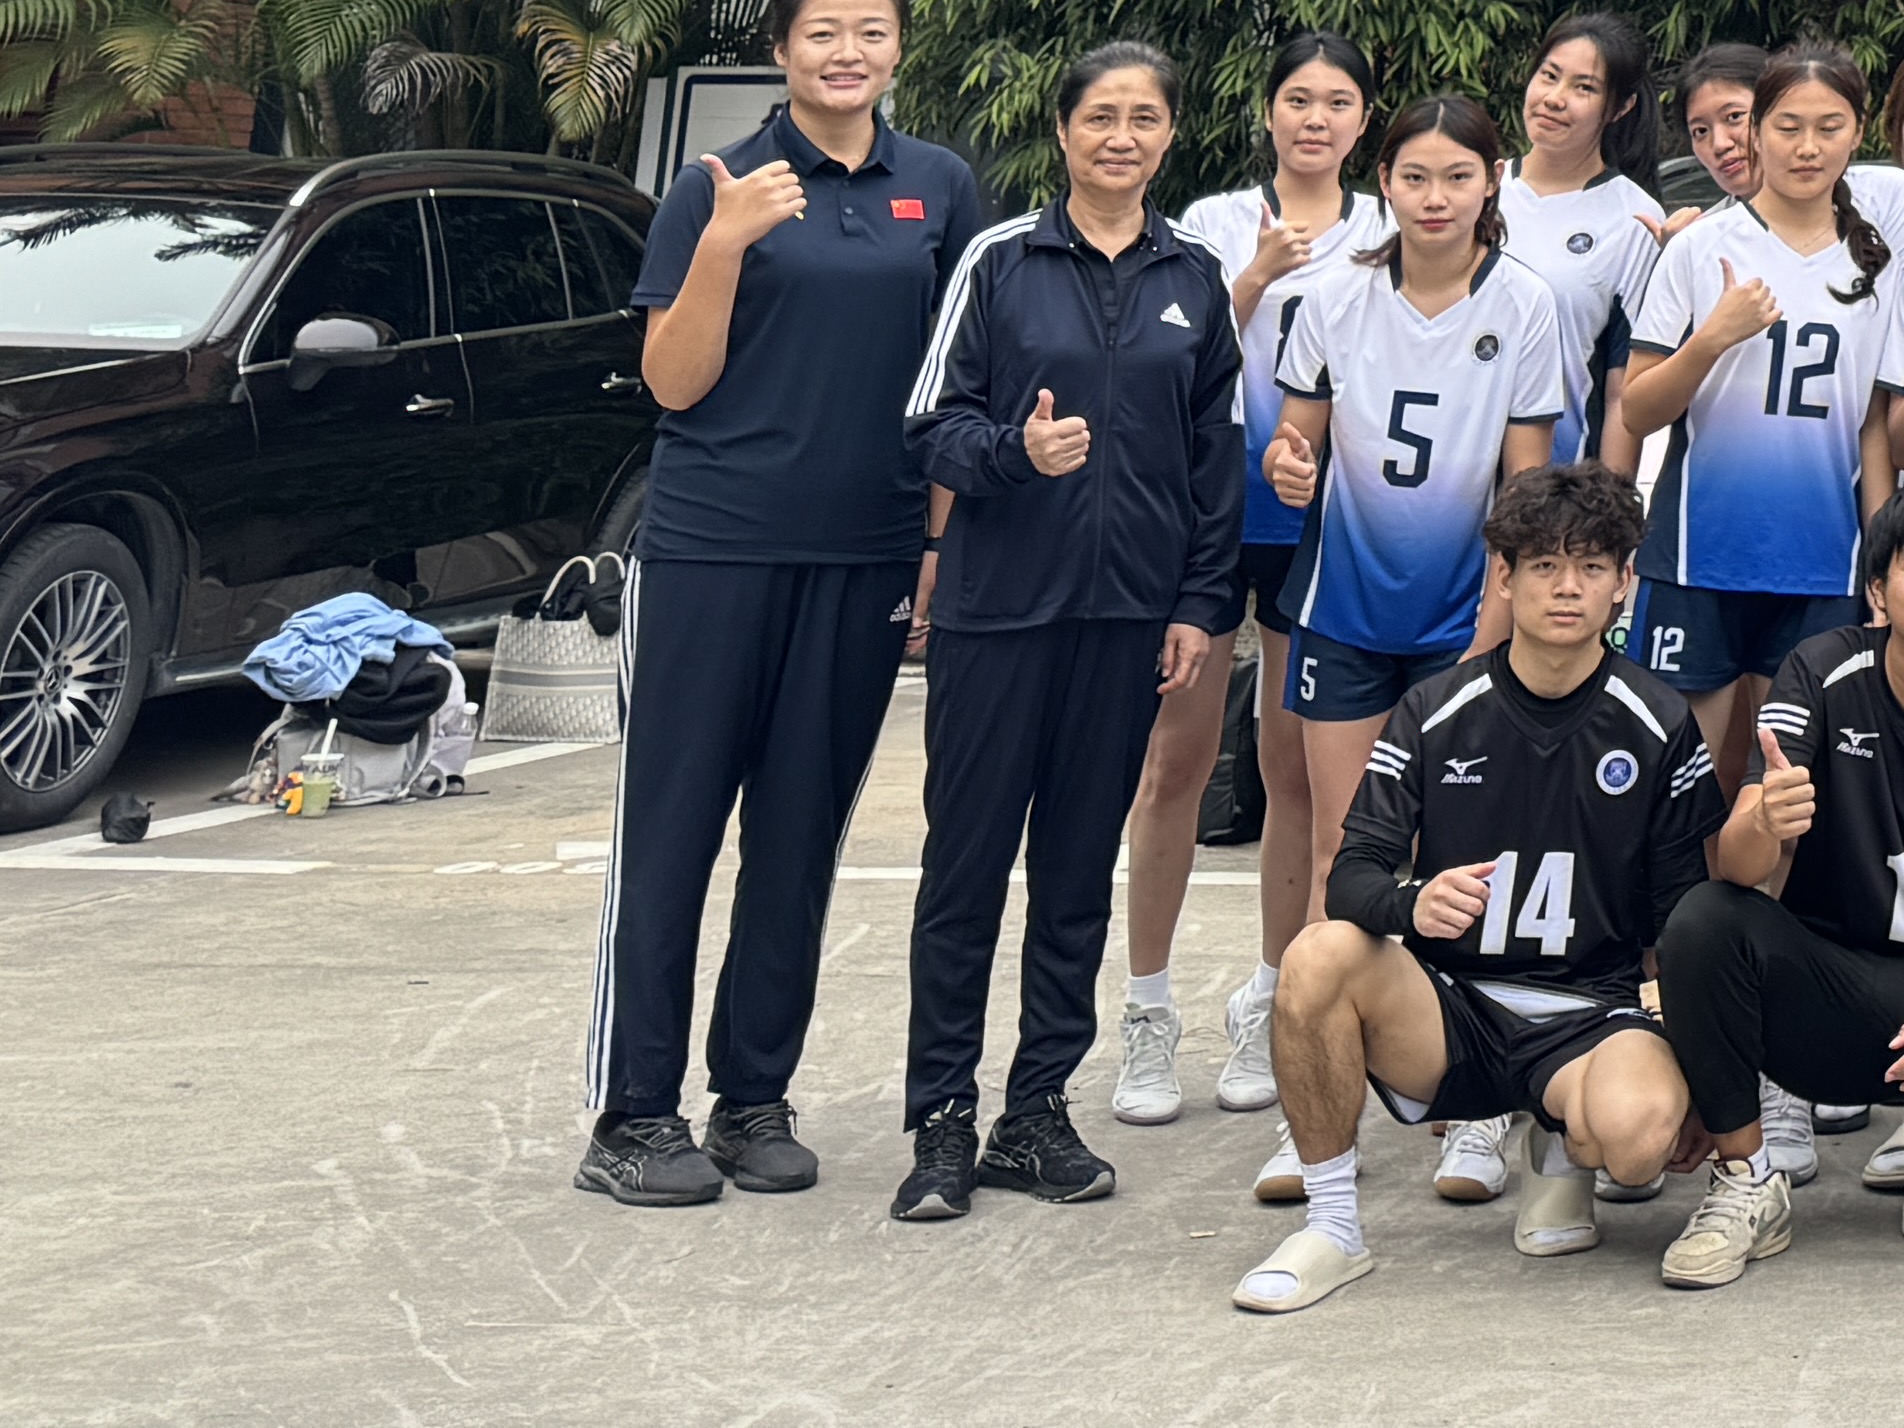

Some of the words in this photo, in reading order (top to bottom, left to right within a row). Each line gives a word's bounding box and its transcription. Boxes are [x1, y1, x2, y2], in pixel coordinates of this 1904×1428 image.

[1764, 319, 1840, 419] 12
[1383, 390, 1439, 488] 5
[1300, 657, 1318, 701] 5
[1650, 626, 1684, 672] 12
[1479, 850, 1575, 956] 14
